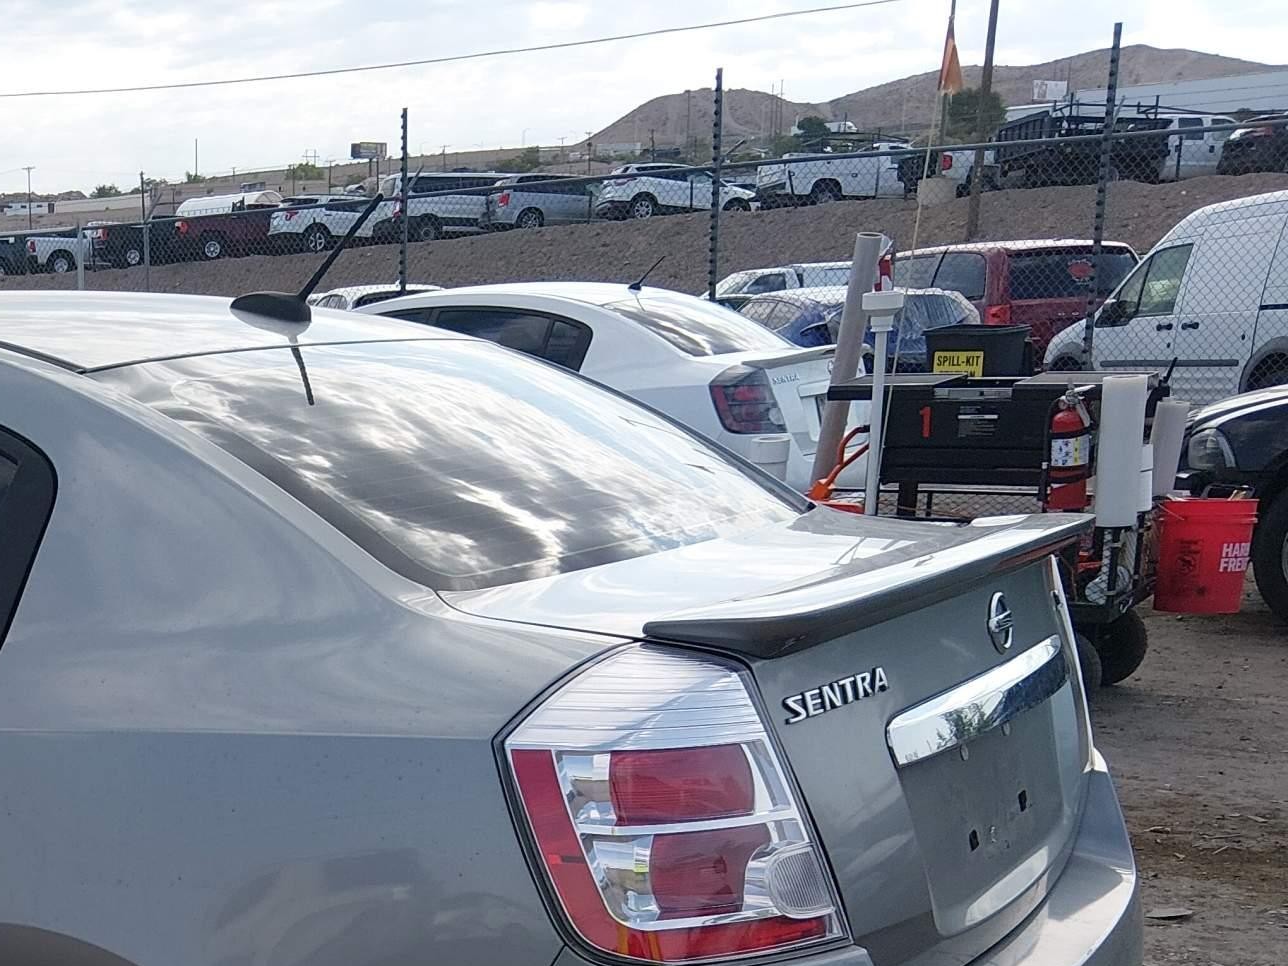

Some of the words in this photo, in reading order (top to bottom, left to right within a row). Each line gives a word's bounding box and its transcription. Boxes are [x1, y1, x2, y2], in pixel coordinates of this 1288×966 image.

[937, 355, 980, 367] SPILL-KIT
[920, 406, 931, 438] 1
[782, 667, 889, 725] SENTRA
